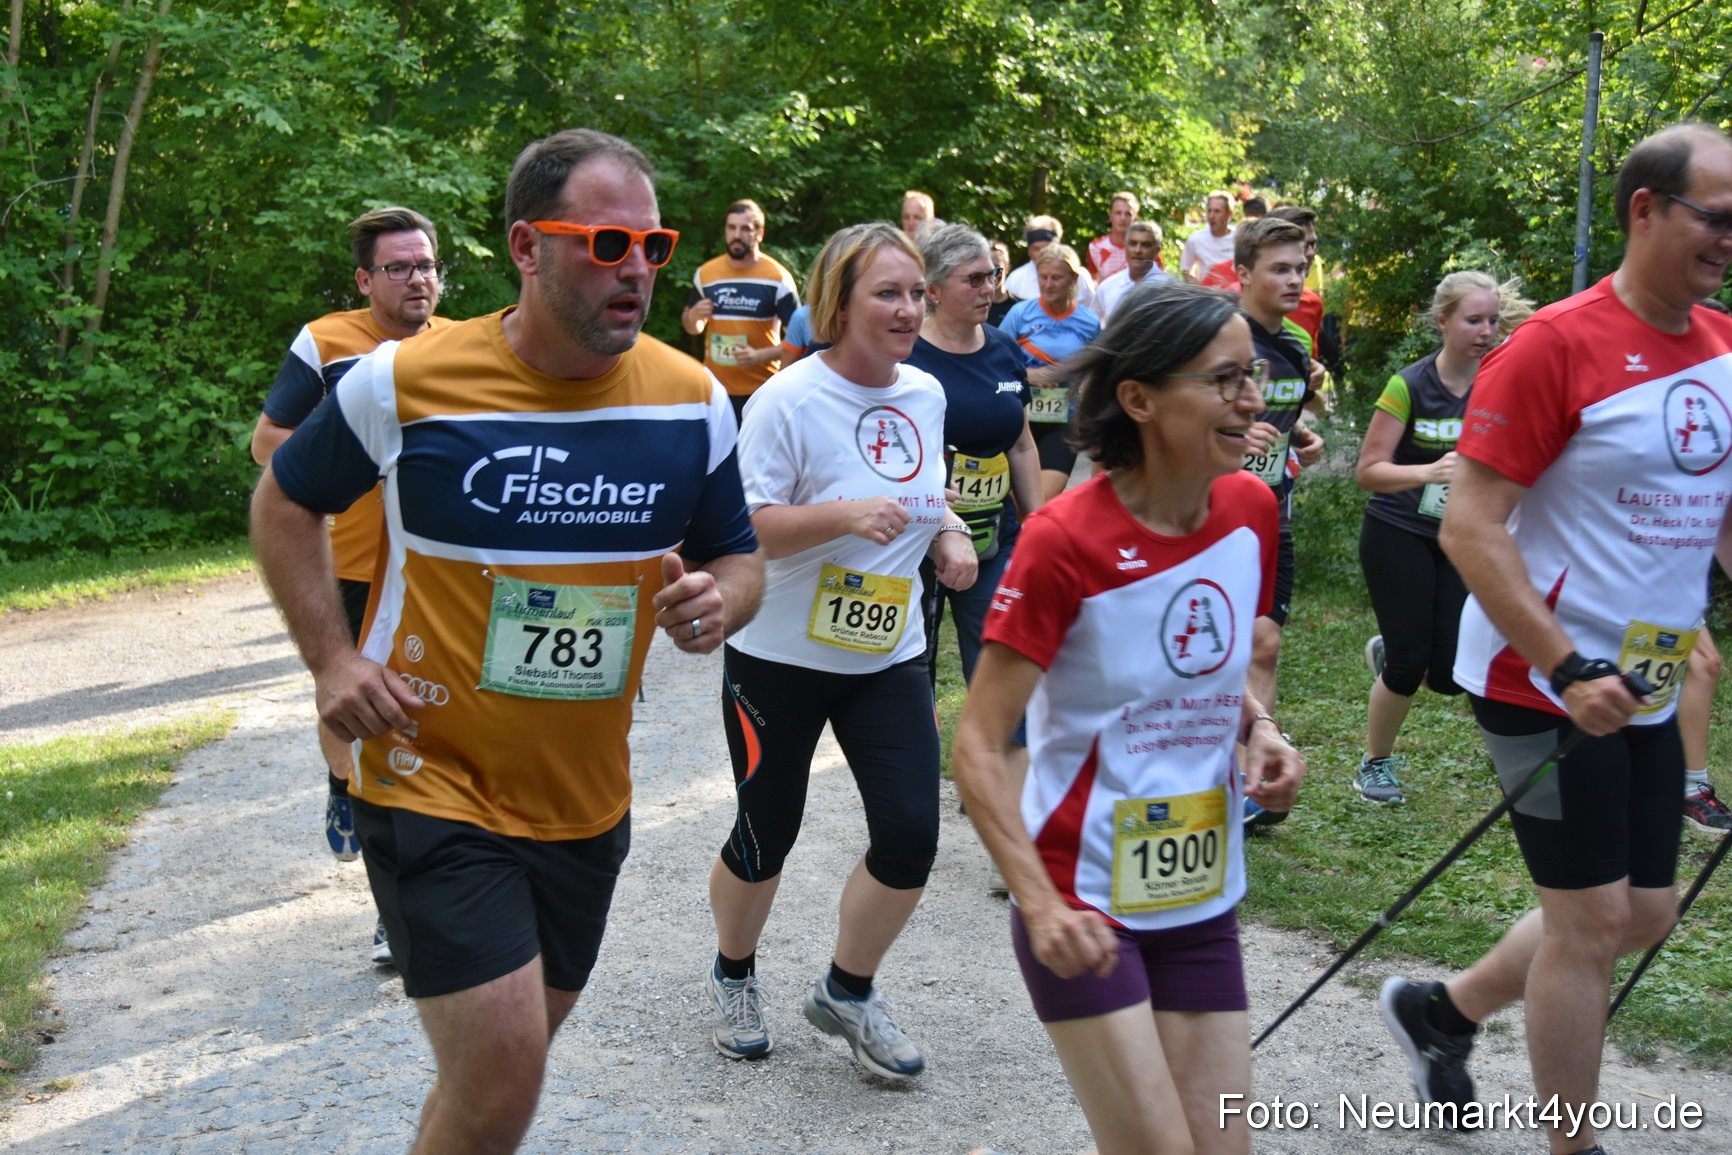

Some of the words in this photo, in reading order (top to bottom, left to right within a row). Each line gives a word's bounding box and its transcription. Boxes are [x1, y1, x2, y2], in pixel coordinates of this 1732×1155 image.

[718, 295, 762, 307] Fischer
[1029, 400, 1062, 413] 1912
[501, 473, 666, 506] Fischer
[955, 473, 1003, 498] 1411
[898, 496, 920, 508] MIT
[1616, 487, 1684, 508] LAUFEN
[1686, 494, 1713, 508] MIT
[516, 510, 653, 525] AUTOMOBILE
[1630, 514, 1649, 527] Dr.
[1652, 515, 1682, 528] Heck
[828, 596, 898, 633] 1898
[523, 624, 604, 668] 783
[514, 665, 559, 680] Siebald
[562, 669, 604, 681] Thomas
[1132, 829, 1218, 880] 1900
